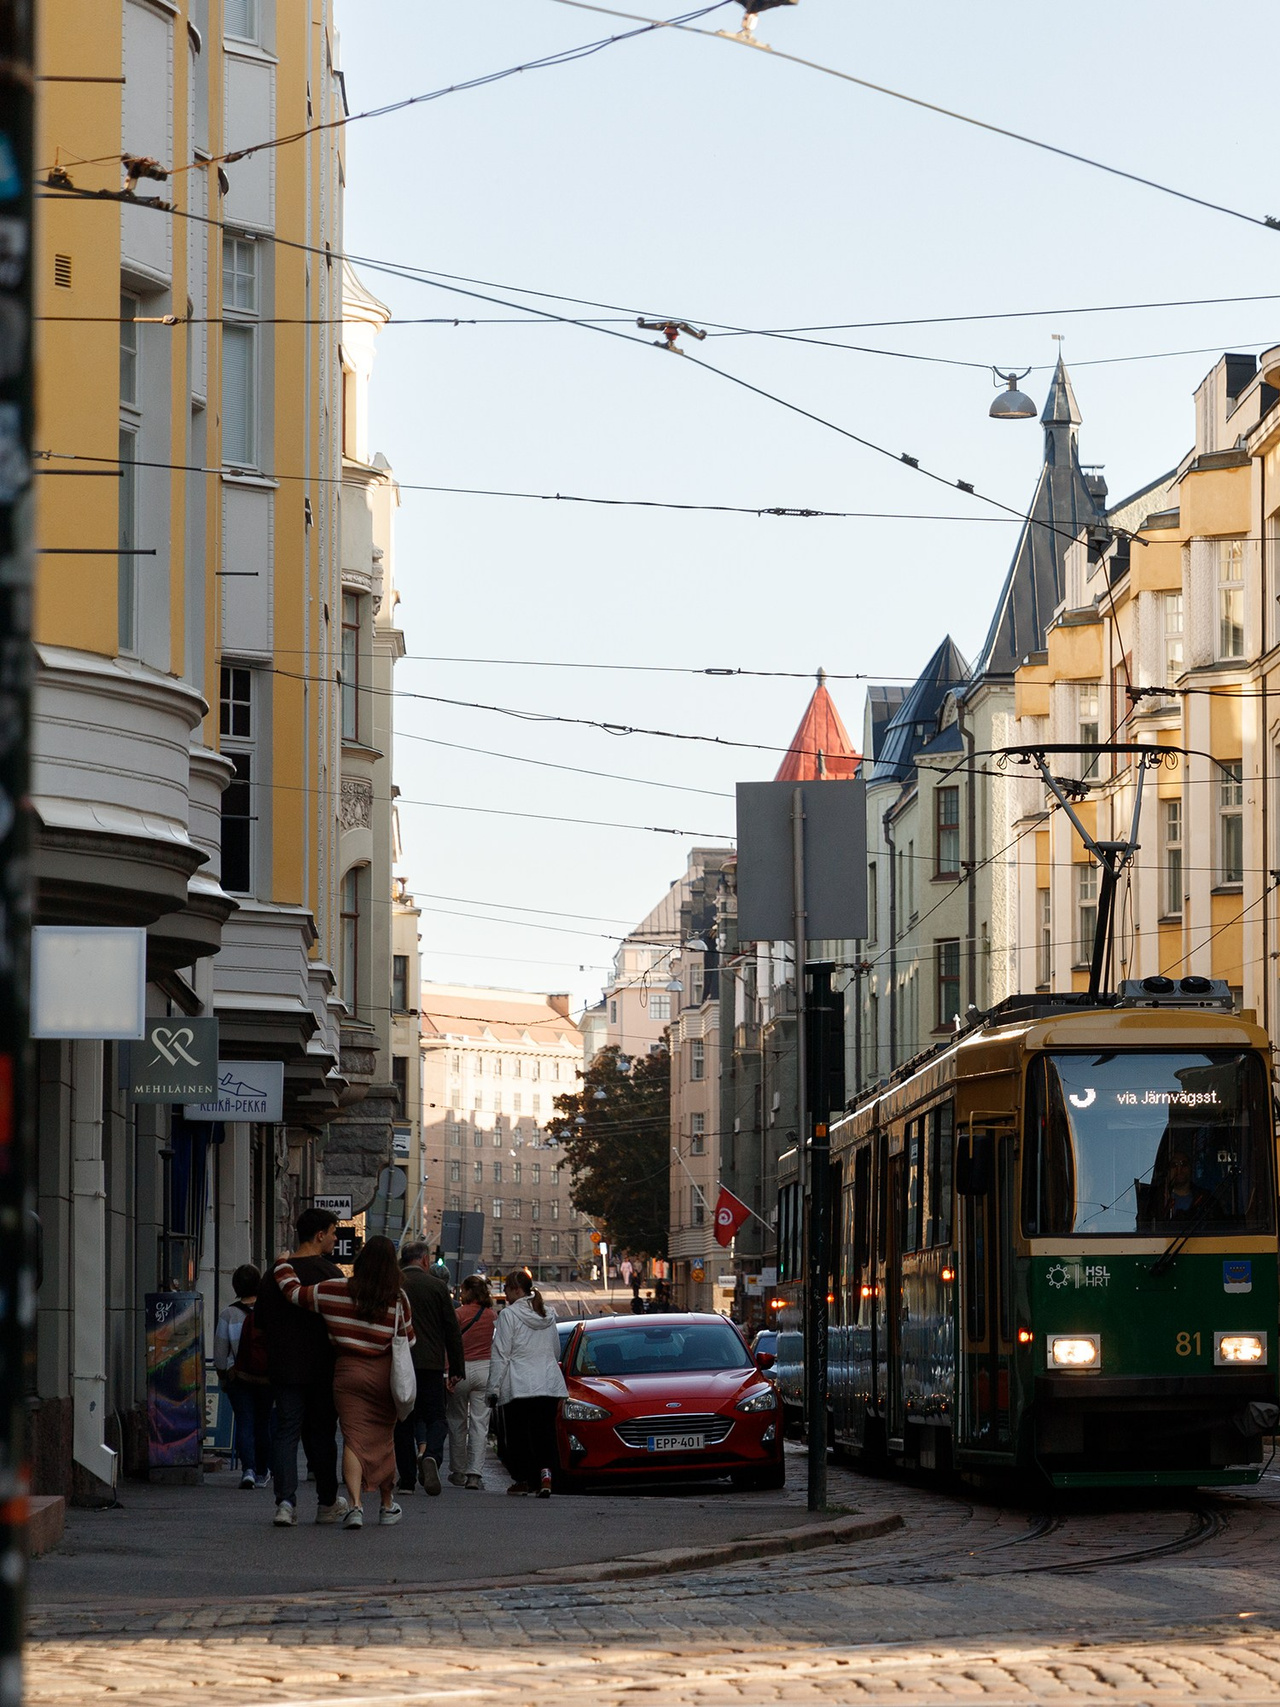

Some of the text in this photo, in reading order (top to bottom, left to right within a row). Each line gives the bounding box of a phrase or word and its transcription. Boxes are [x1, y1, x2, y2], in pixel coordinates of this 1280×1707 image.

[134, 1083, 213, 1093] MEHILÄINEN
[1117, 1090, 1222, 1107] via Järnvägsst.
[315, 1200, 350, 1208] TRICANA
[1085, 1265, 1111, 1276] HSL
[1085, 1276, 1111, 1287] HRT
[1175, 1331, 1201, 1356] 81
[656, 1436, 701, 1449] EPP-401
